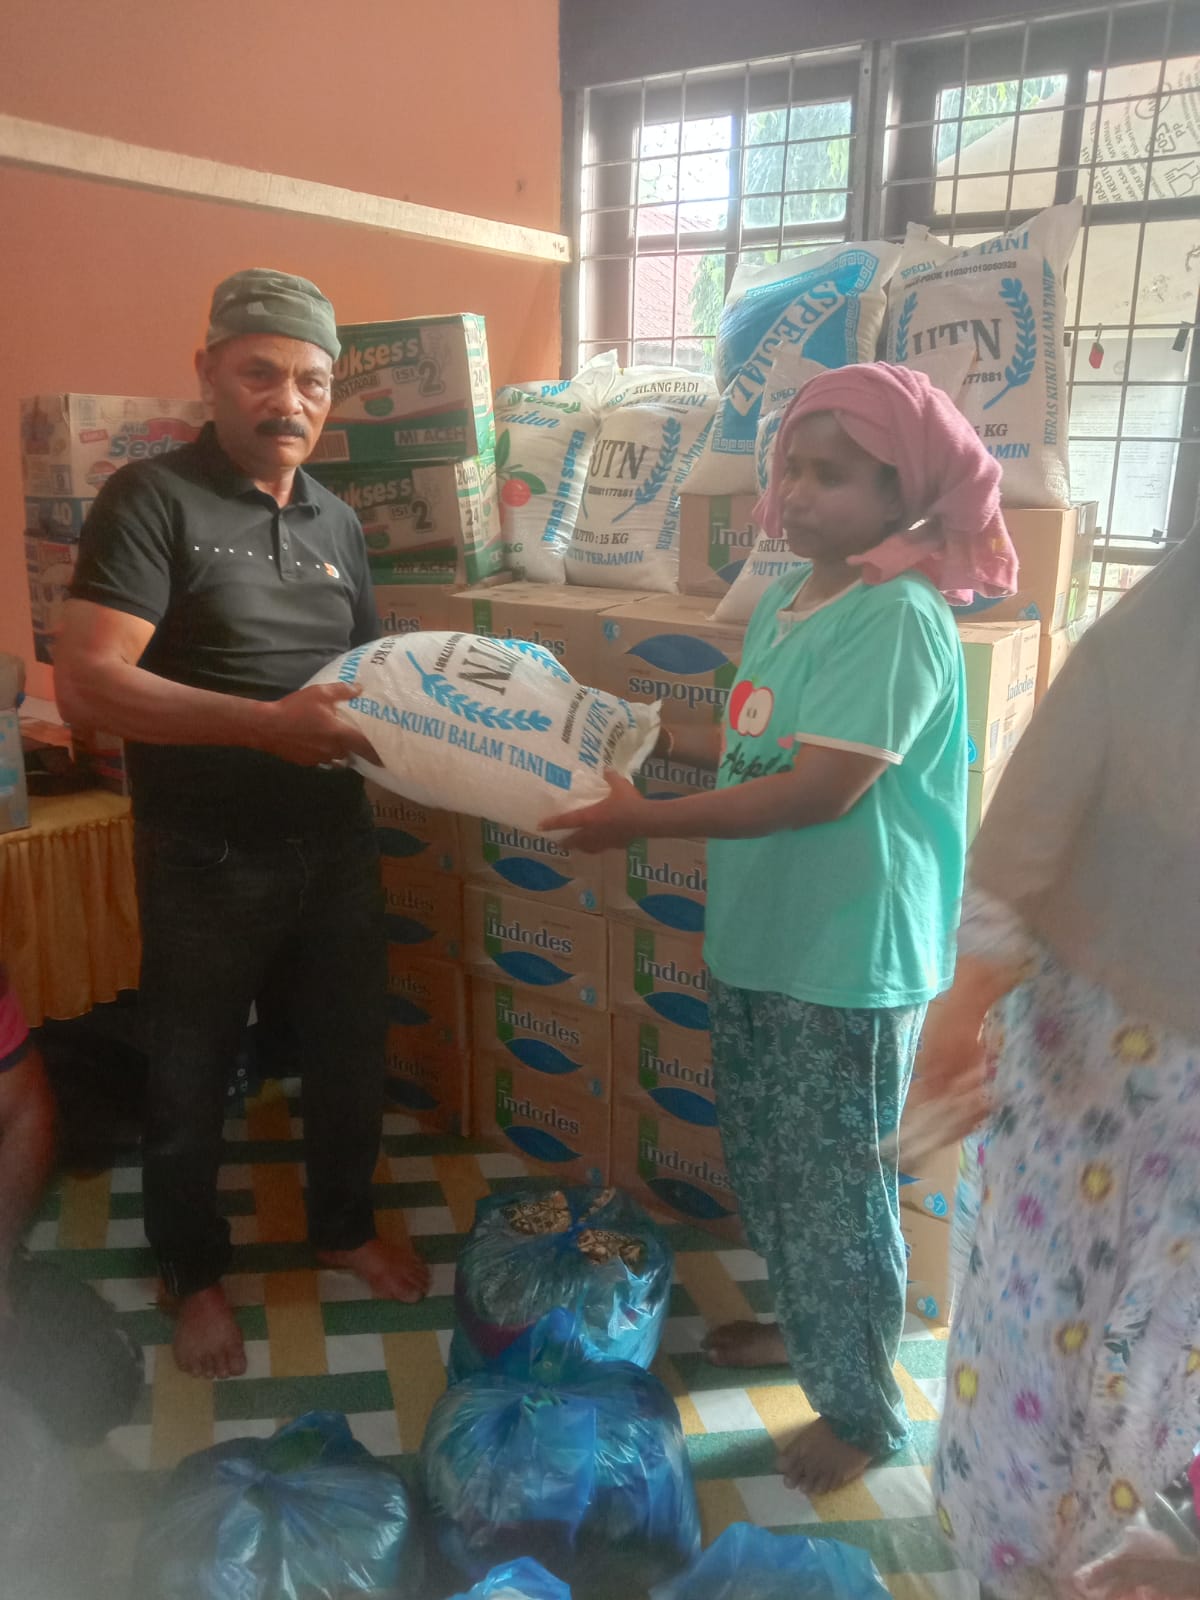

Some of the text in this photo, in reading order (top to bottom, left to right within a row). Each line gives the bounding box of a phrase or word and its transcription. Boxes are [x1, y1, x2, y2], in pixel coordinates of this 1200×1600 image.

[418, 359, 442, 394] 2
[673, 382, 700, 393] PADI
[1045, 361, 1058, 400] KUKU
[400, 427, 467, 444] MI ACEH
[984, 423, 1008, 437] KG
[1043, 402, 1058, 446] BERAS
[411, 500, 433, 531] 2
[611, 532, 630, 545] KG
[584, 550, 645, 566] TERJAMIN
[447, 724, 506, 763] BALAM
[508, 744, 543, 779] TANI
[487, 916, 573, 954] Indodes
[499, 1003, 581, 1046] Indodes
[498, 1089, 581, 1136] Indodes
